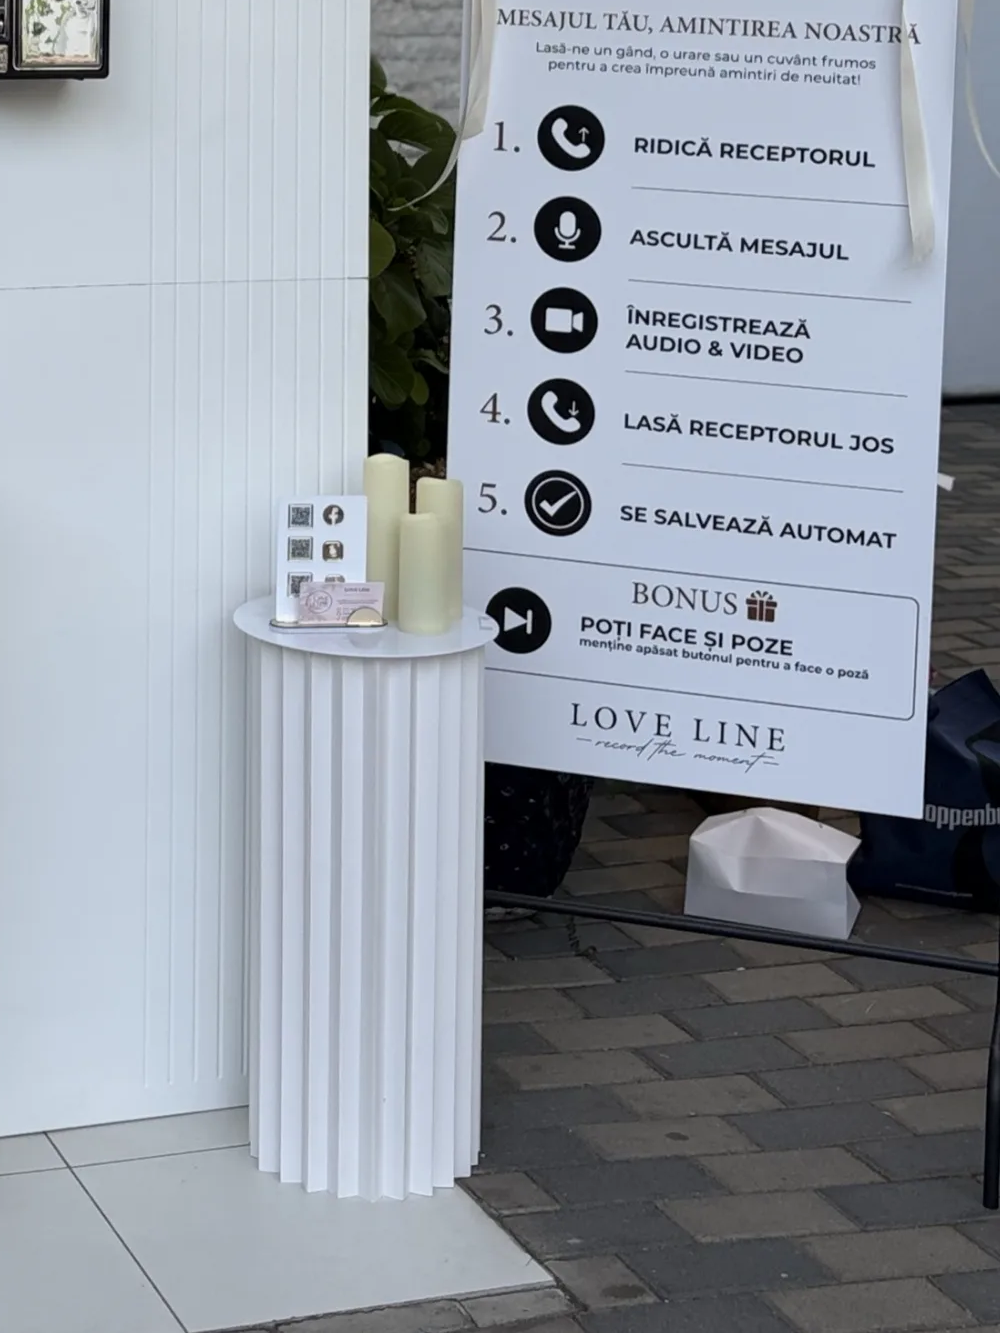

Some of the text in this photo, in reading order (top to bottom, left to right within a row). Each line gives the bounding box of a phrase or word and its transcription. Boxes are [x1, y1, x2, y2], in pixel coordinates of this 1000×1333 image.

[497, 8, 921, 44] MESAJUL TĂU, AMINTIREA NOASTRĂ
[536, 42, 877, 69] Lasă-ne un gând, o urare sau un cuvânt frumos
[548, 60, 596, 72] pentru
[611, 63, 642, 74] crea
[645, 63, 716, 79] împreună
[719, 67, 777, 81] amintiri
[781, 70, 800, 82] de
[803, 72, 861, 85] neuitat!
[493, 121, 876, 168] 1. RIDICĂ RECEPTORUL
[486, 211, 850, 261] 2. ASCULTĂ MESAJUL
[483, 304, 812, 340] 3. ÎNREGISTREAZĂ
[625, 332, 804, 365] AUDIO & VIDEO
[479, 393, 895, 455] 4. LASĂ RECEPTORUL JOS
[477, 483, 897, 549] 5. SE SALVEAZĂ AUTOMAT
[631, 581, 739, 616] BONUS
[580, 616, 794, 656] POȚI FACE ȘI POZE
[579, 637, 870, 680] menține apăsat butonul pentru a face o poză
[570, 703, 786, 752] LOVE LINE
[595, 738, 774, 774] record the moment
